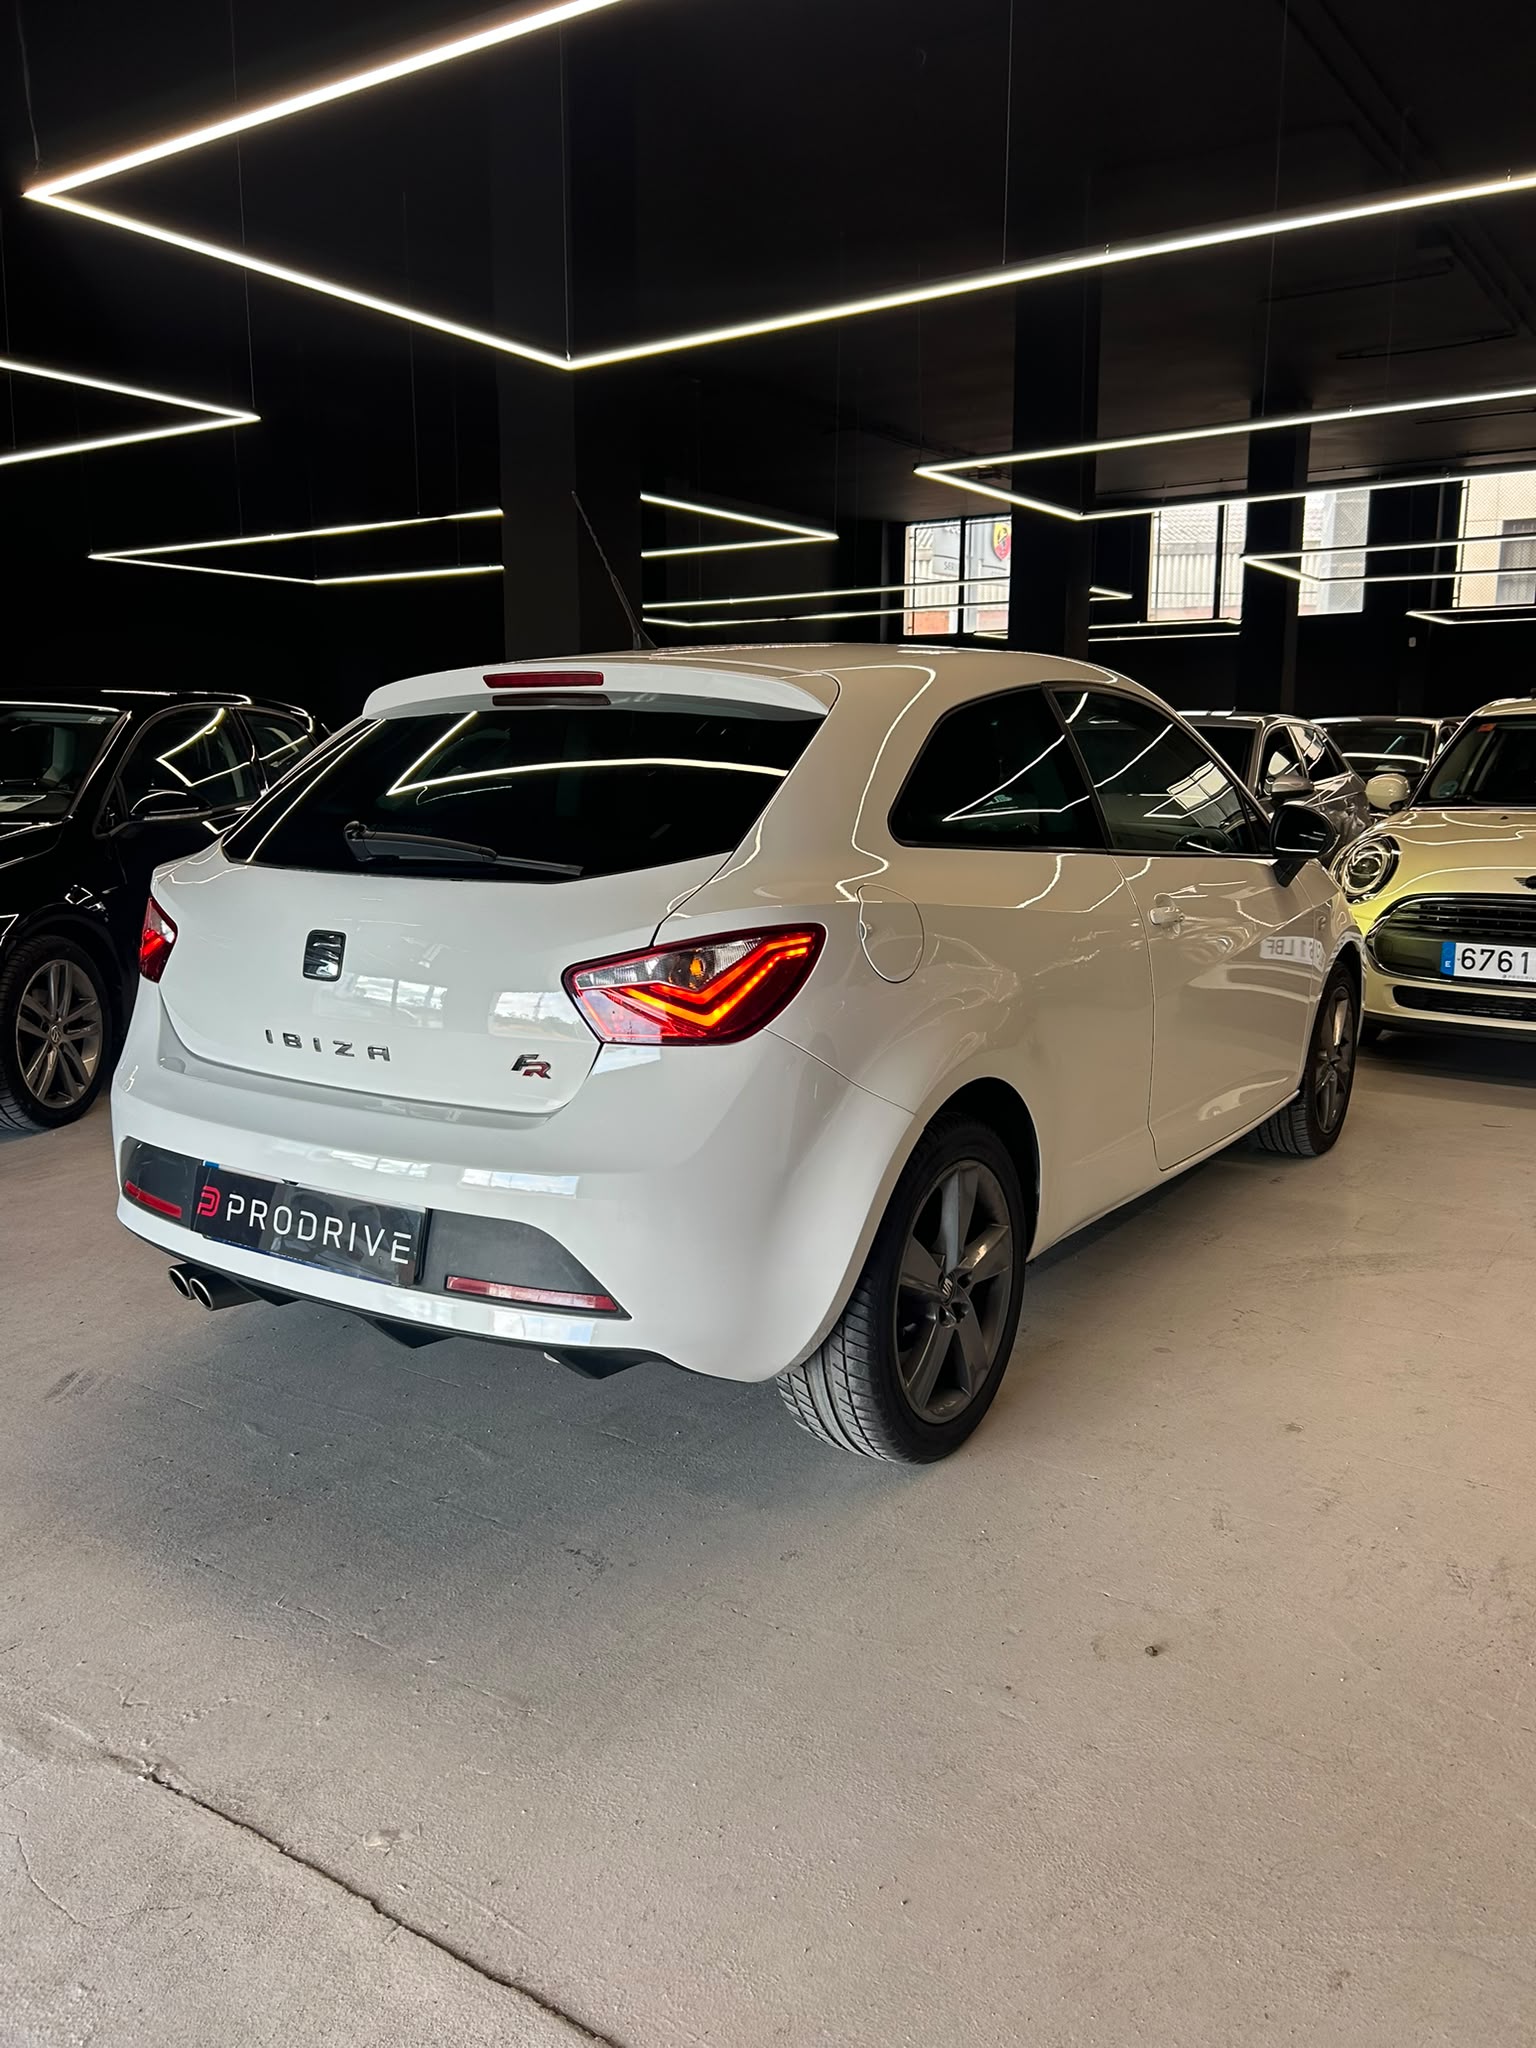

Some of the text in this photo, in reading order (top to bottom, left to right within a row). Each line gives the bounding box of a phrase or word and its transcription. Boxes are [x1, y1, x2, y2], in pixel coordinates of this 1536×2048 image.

[1444, 947, 1530, 975] E 6761
[265, 1029, 391, 1062] IBIZA
[511, 1053, 552, 1079] FR
[226, 1193, 412, 1264] PRODRIVE
